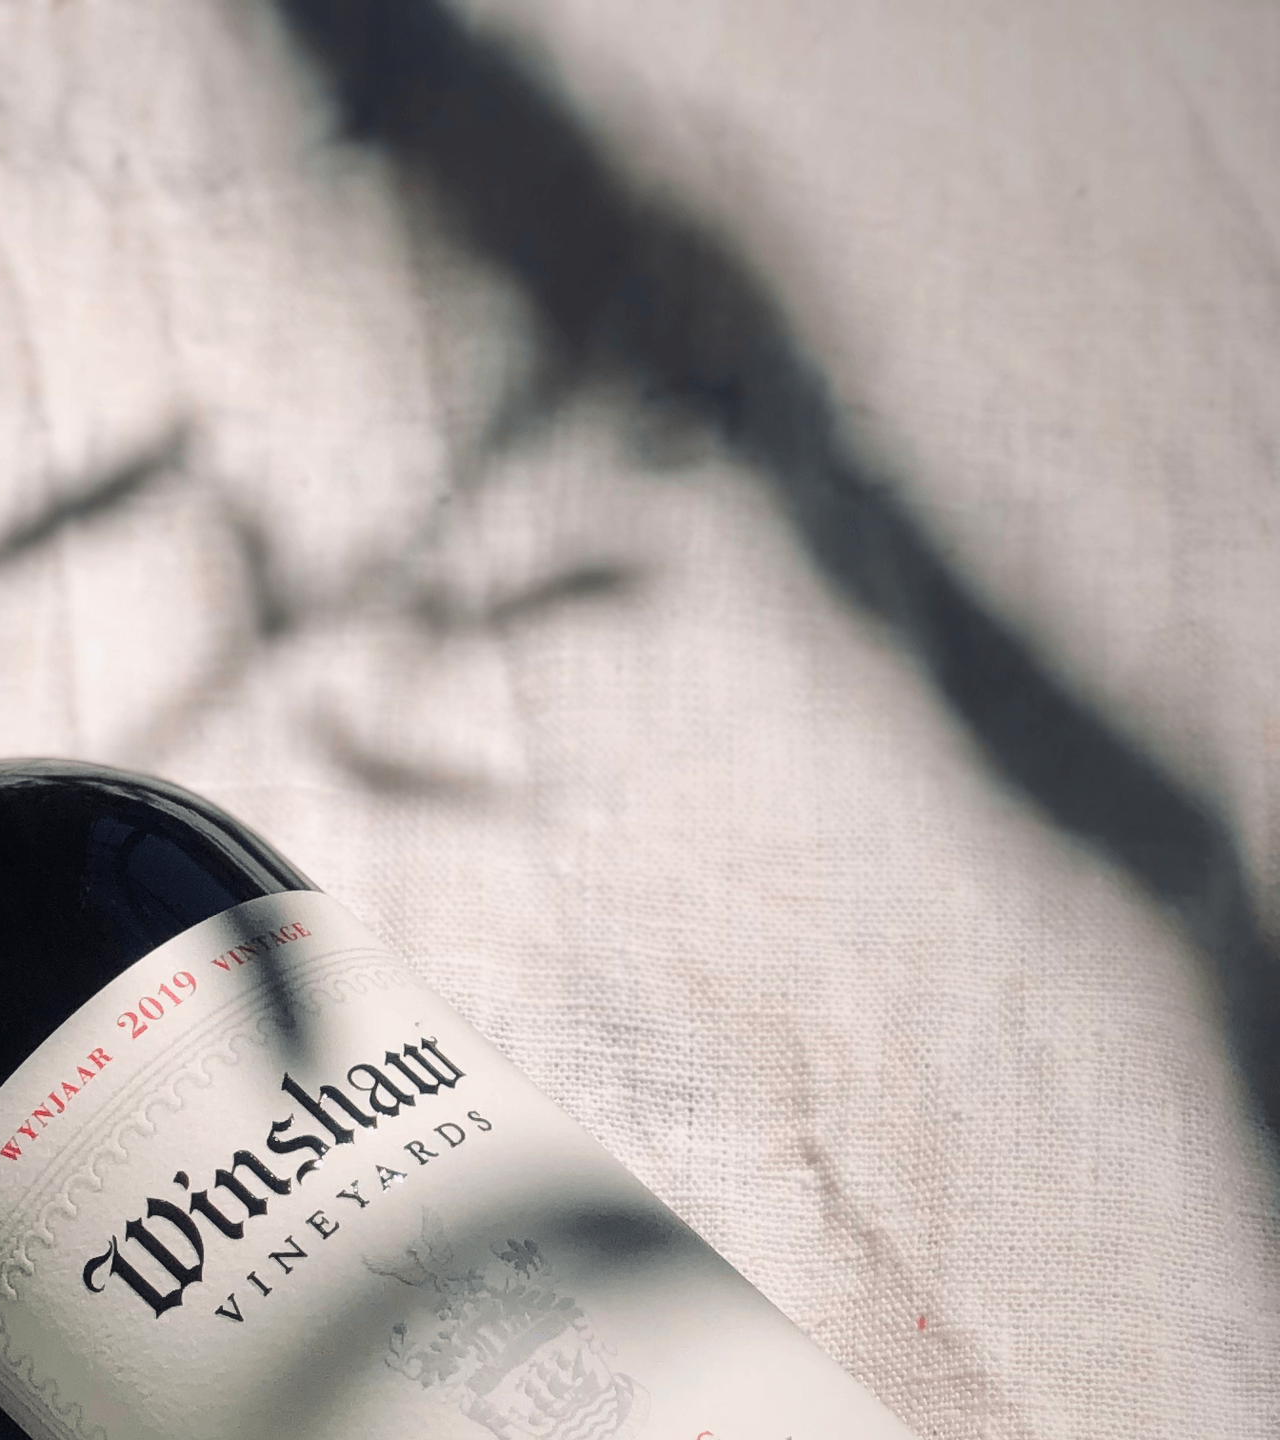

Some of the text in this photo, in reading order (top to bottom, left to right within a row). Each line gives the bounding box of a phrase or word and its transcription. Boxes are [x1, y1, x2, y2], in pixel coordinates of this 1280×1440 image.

[0, 921, 312, 1163] WYNJAAR 2019 VINTAGE
[81, 1032, 467, 1320] Winshaw
[215, 1110, 493, 1323] VINEYARDS
